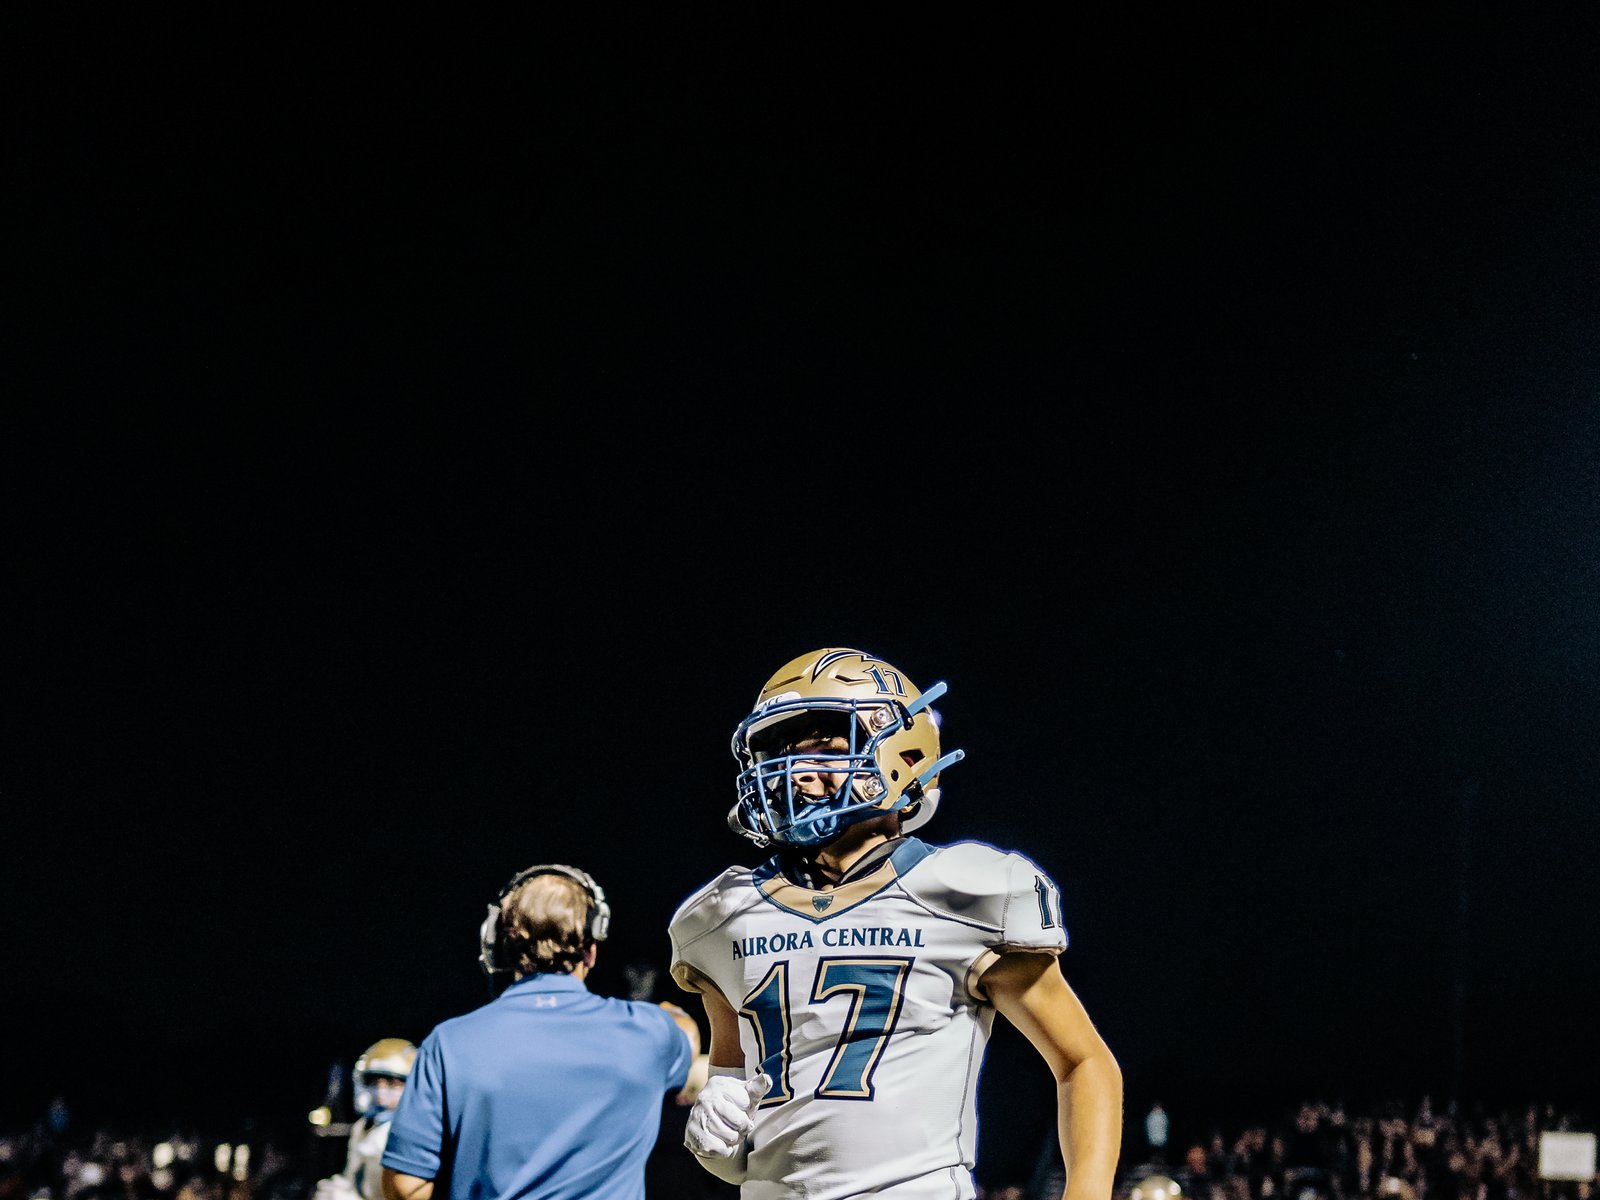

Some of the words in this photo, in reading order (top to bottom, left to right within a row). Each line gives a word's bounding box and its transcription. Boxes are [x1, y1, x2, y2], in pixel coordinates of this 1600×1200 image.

[863, 664, 908, 698] 17
[731, 930, 814, 961] AURORA
[822, 926, 926, 949] CENTRAL
[738, 956, 916, 1110] 17
